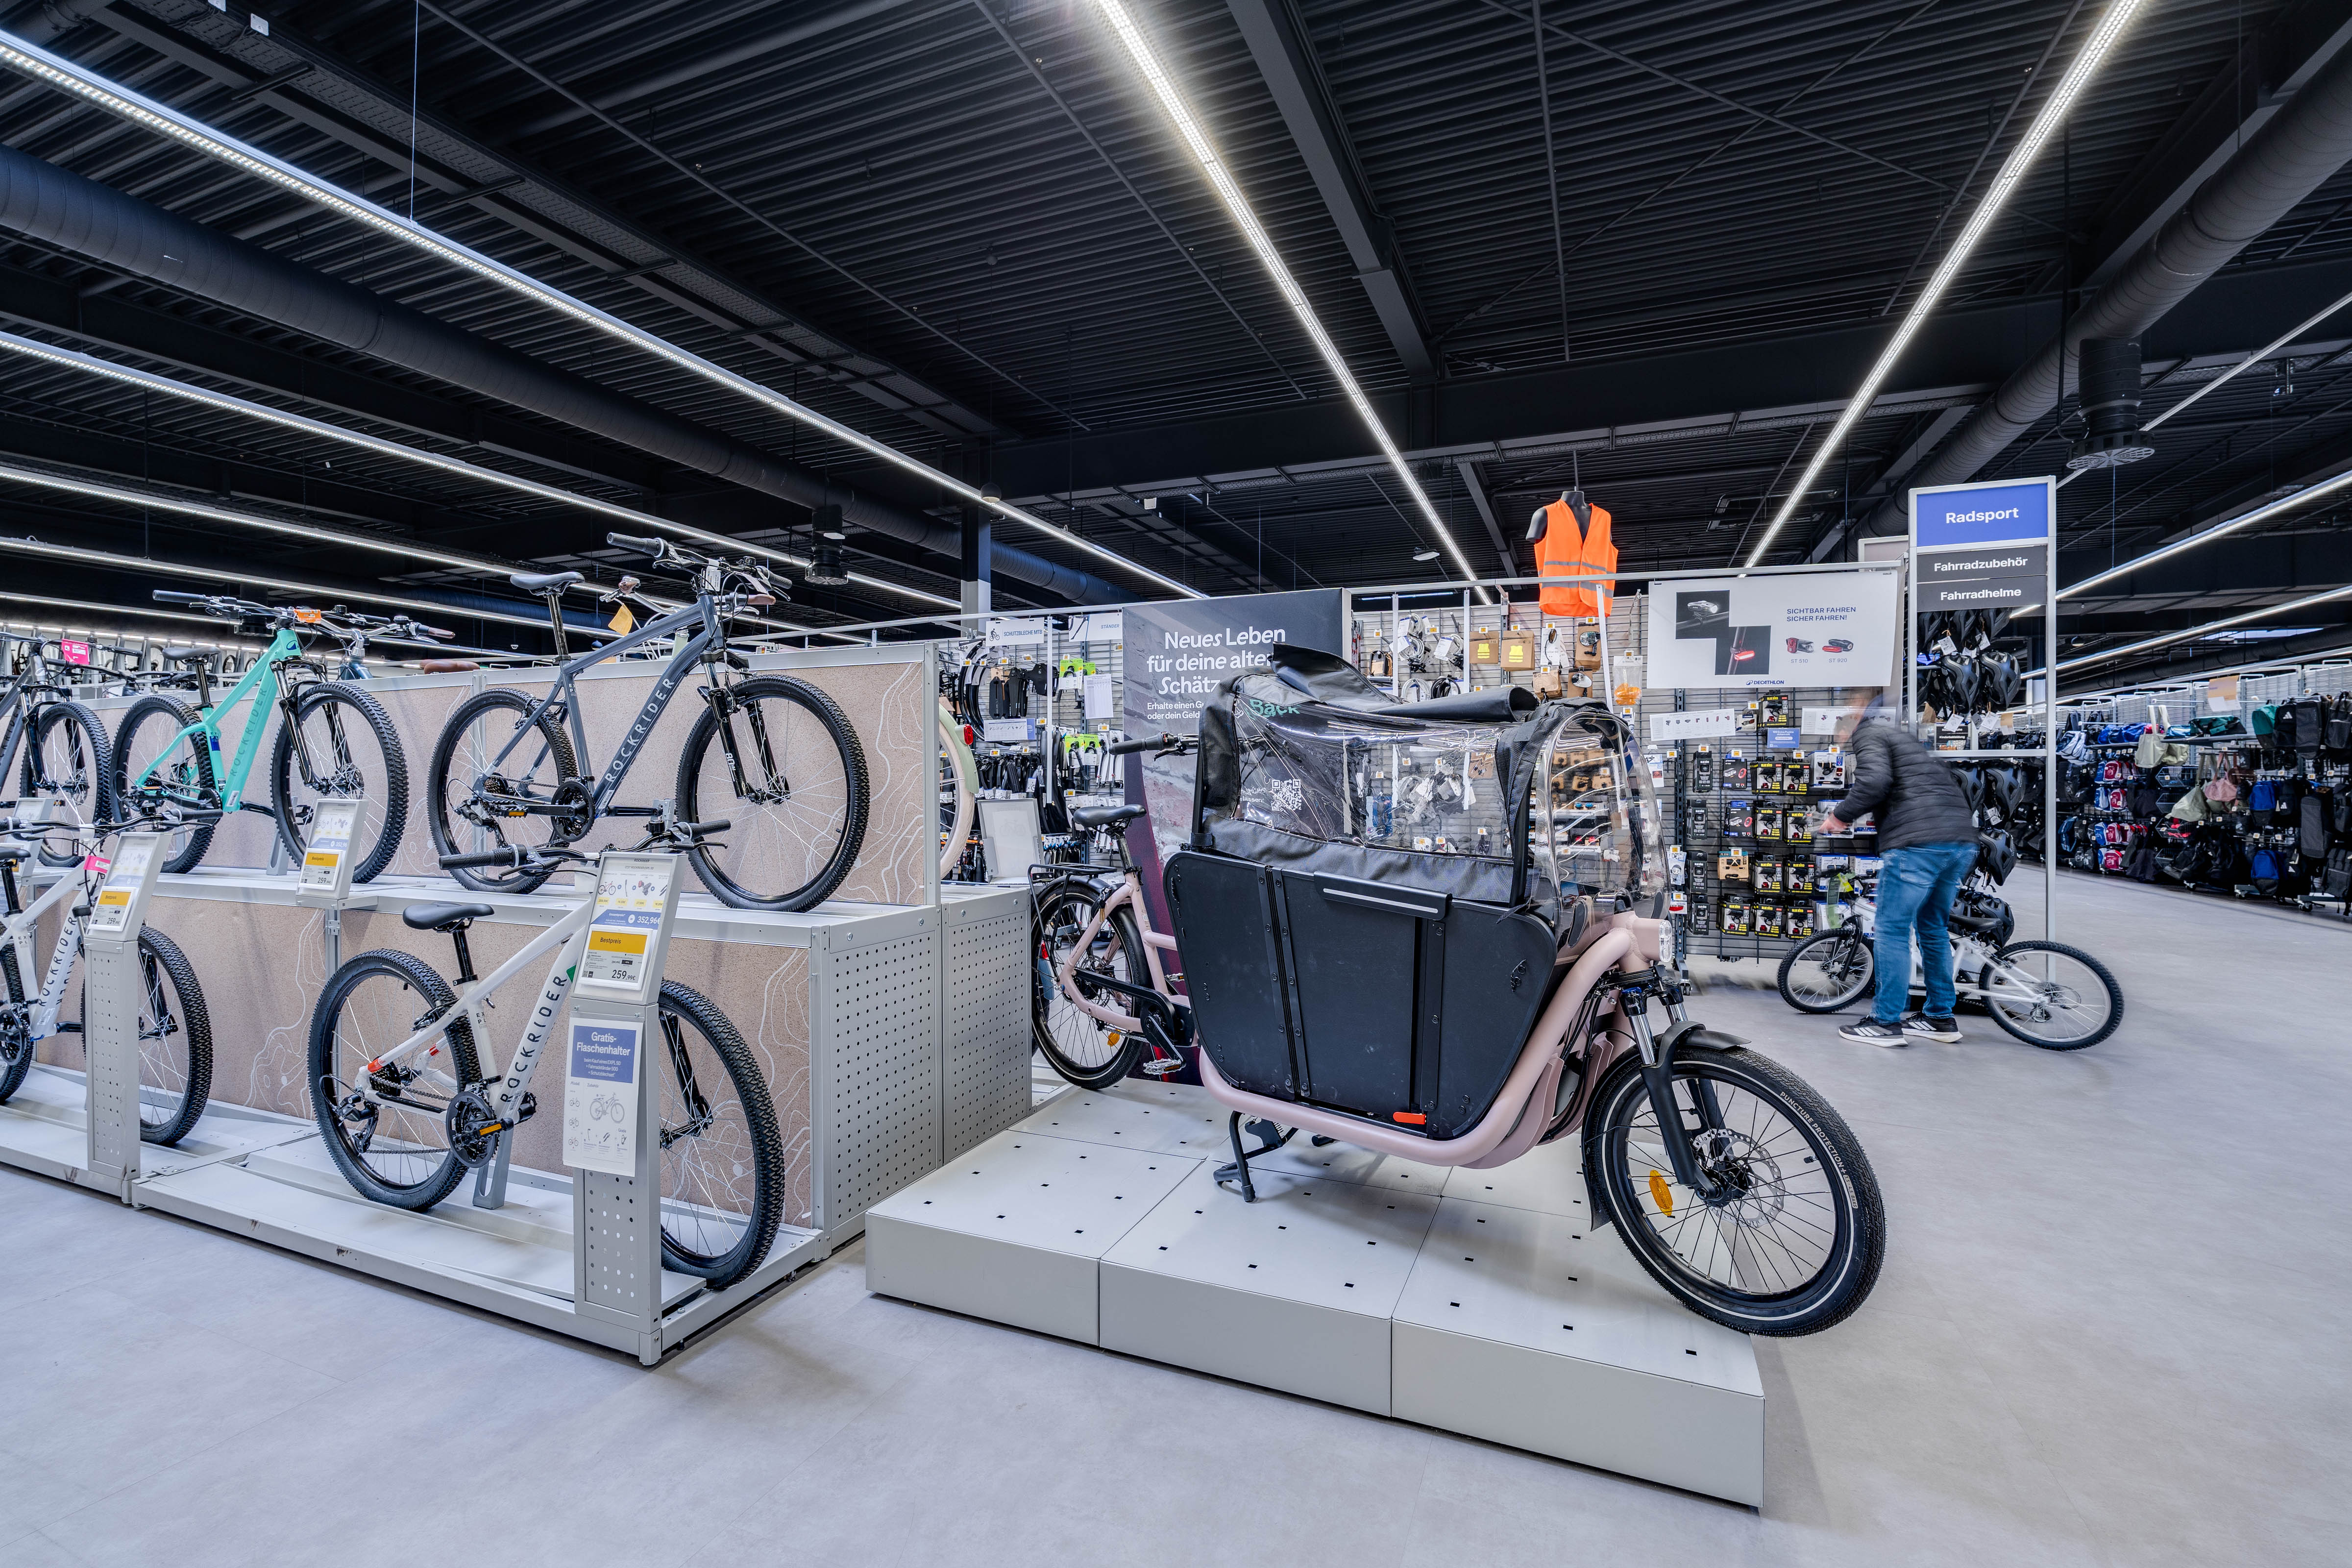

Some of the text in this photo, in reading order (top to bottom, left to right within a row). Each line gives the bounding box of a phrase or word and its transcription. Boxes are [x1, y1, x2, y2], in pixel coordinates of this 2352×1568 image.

[1945, 508, 2019, 524] Radsport
[1934, 557, 2028, 572] Fahrradzubehör
[1940, 588, 2022, 601] Fahrradhelme
[1165, 626, 1286, 649] Neues Leben
[1147, 655, 1173, 673] für
[1176, 652, 1227, 671] deine
[1158, 675, 1221, 694] Schätz
[230, 688, 267, 777] ROCKRIDER
[605, 678, 675, 783] ROCKRIDER
[38, 917, 77, 1007] ROCKRIDER
[611, 969, 636, 980] 259,99€
[500, 976, 567, 1102] ROCKRIDER
[591, 1031, 616, 1043] Gratis-
[576, 1042, 631, 1056] Flaschenhalter
[1780, 1091, 1814, 1124] PUNCTURE
